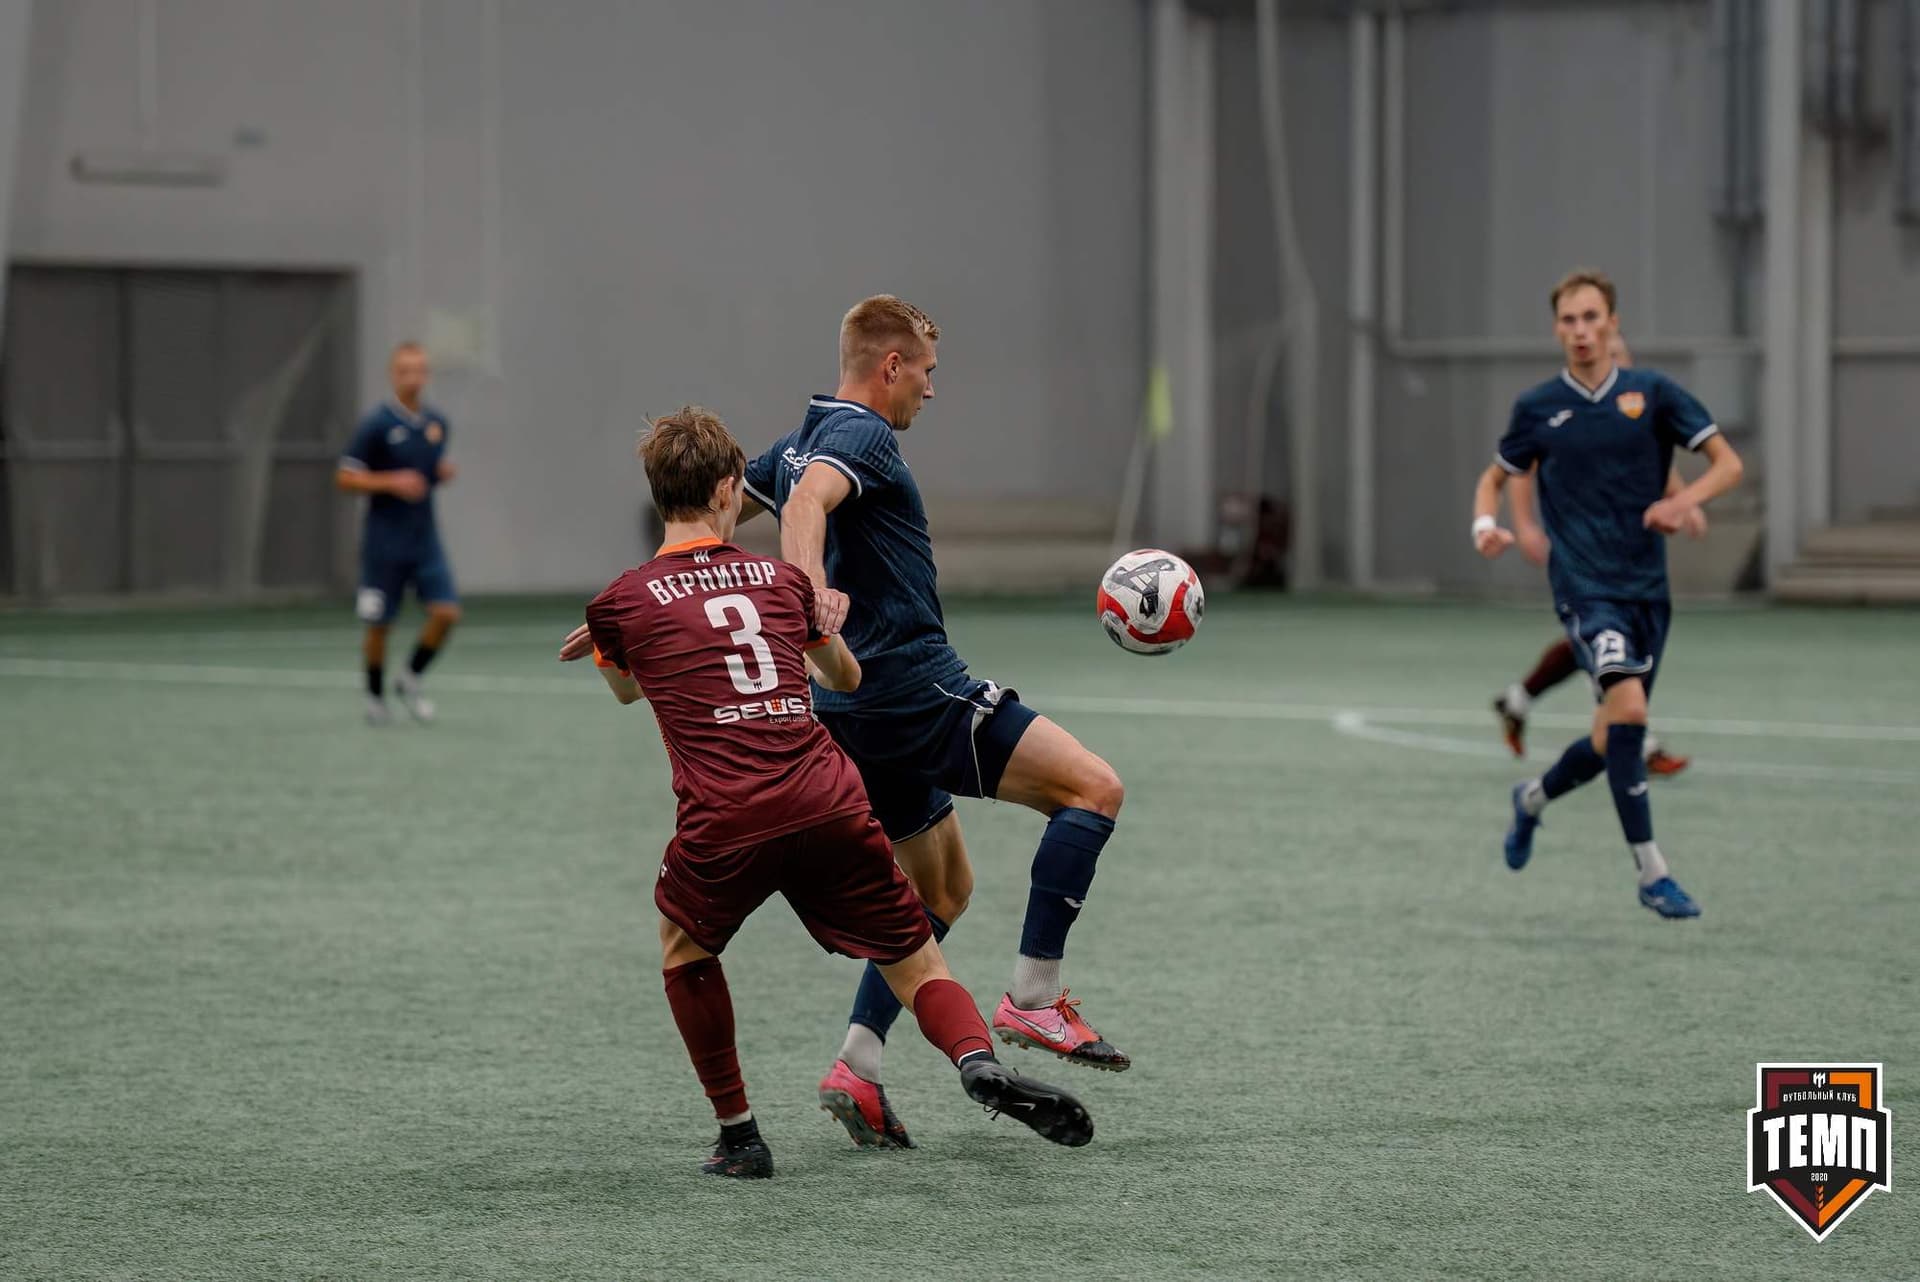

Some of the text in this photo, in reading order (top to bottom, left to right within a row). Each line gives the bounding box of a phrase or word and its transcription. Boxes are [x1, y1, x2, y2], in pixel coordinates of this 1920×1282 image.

[647, 561, 776, 606] ВЕРНИГОР
[703, 593, 778, 695] 3
[713, 697, 806, 724] SEUS
